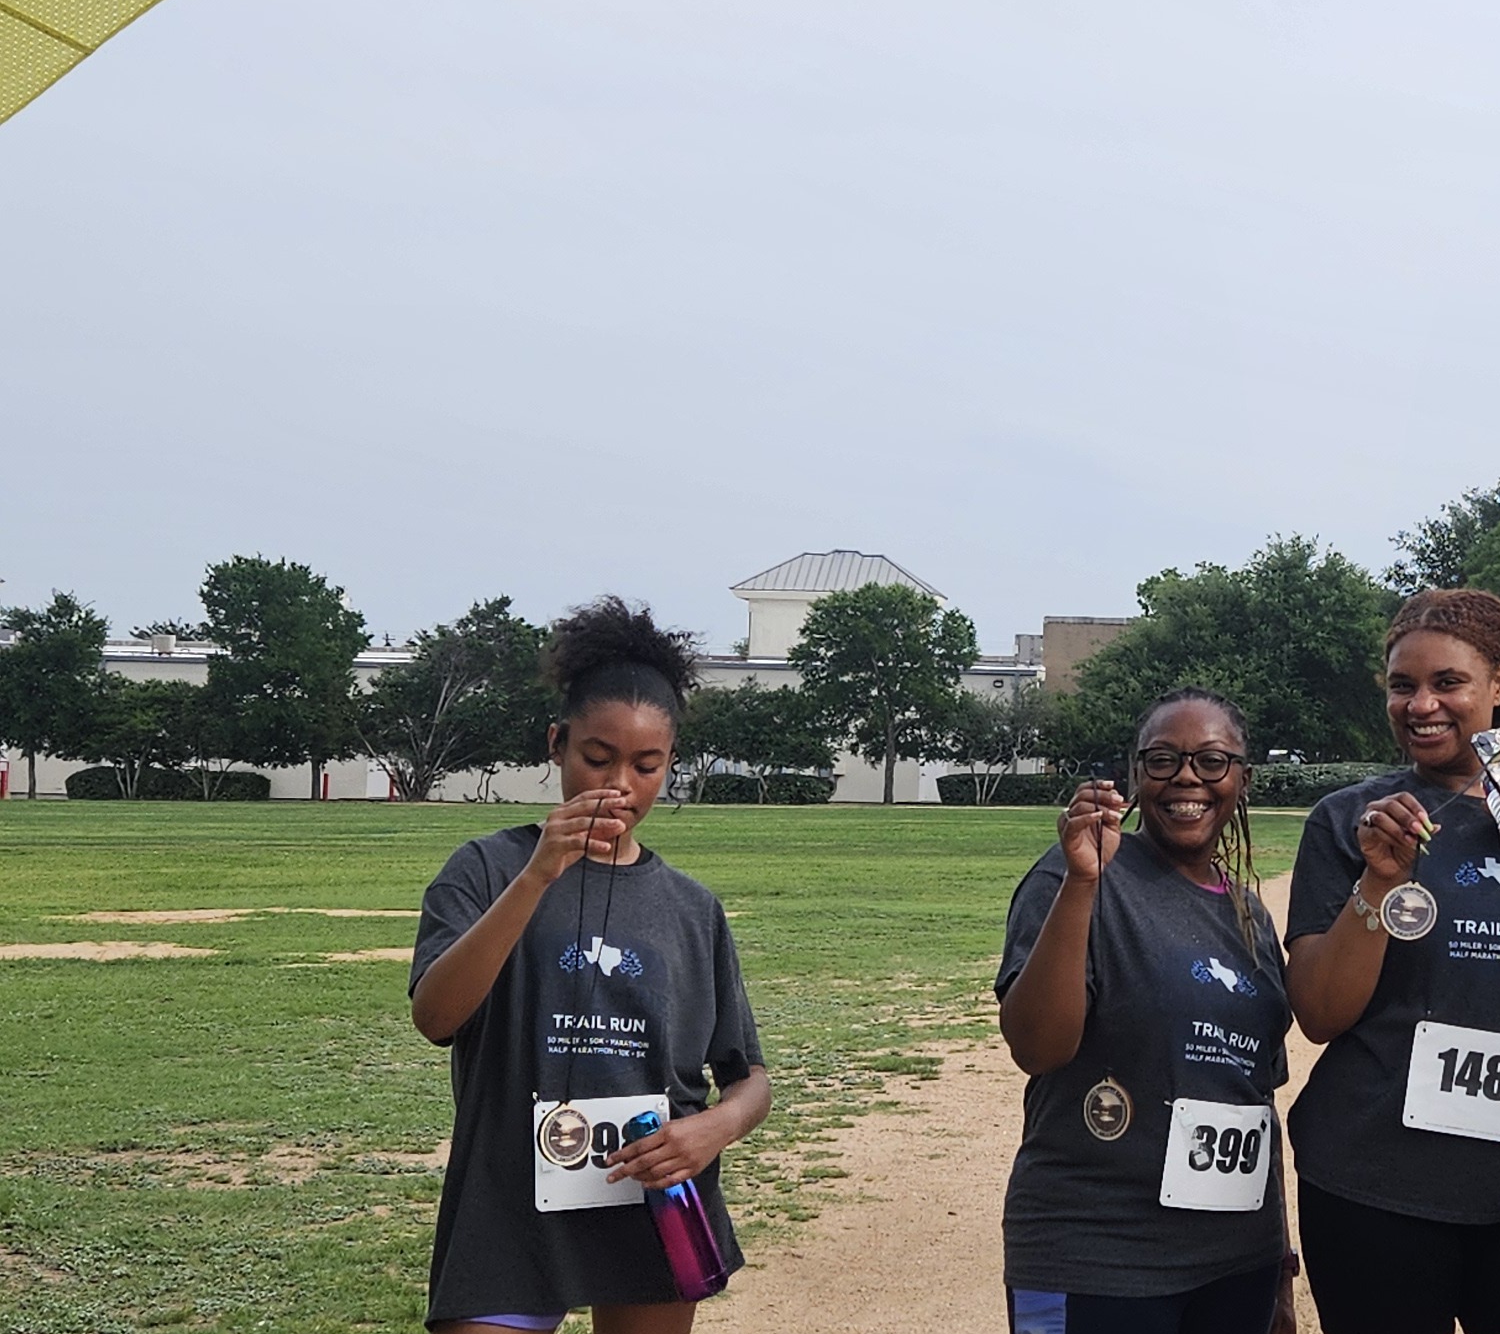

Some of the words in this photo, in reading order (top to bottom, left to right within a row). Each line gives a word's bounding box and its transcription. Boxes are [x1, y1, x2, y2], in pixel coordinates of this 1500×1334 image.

[552, 1014, 607, 1030] TRAIL
[610, 1017, 646, 1033] RUN
[1192, 1021, 1227, 1044] TRAL
[1228, 1032, 1260, 1053] RUN
[1189, 1124, 1261, 1175] 399
